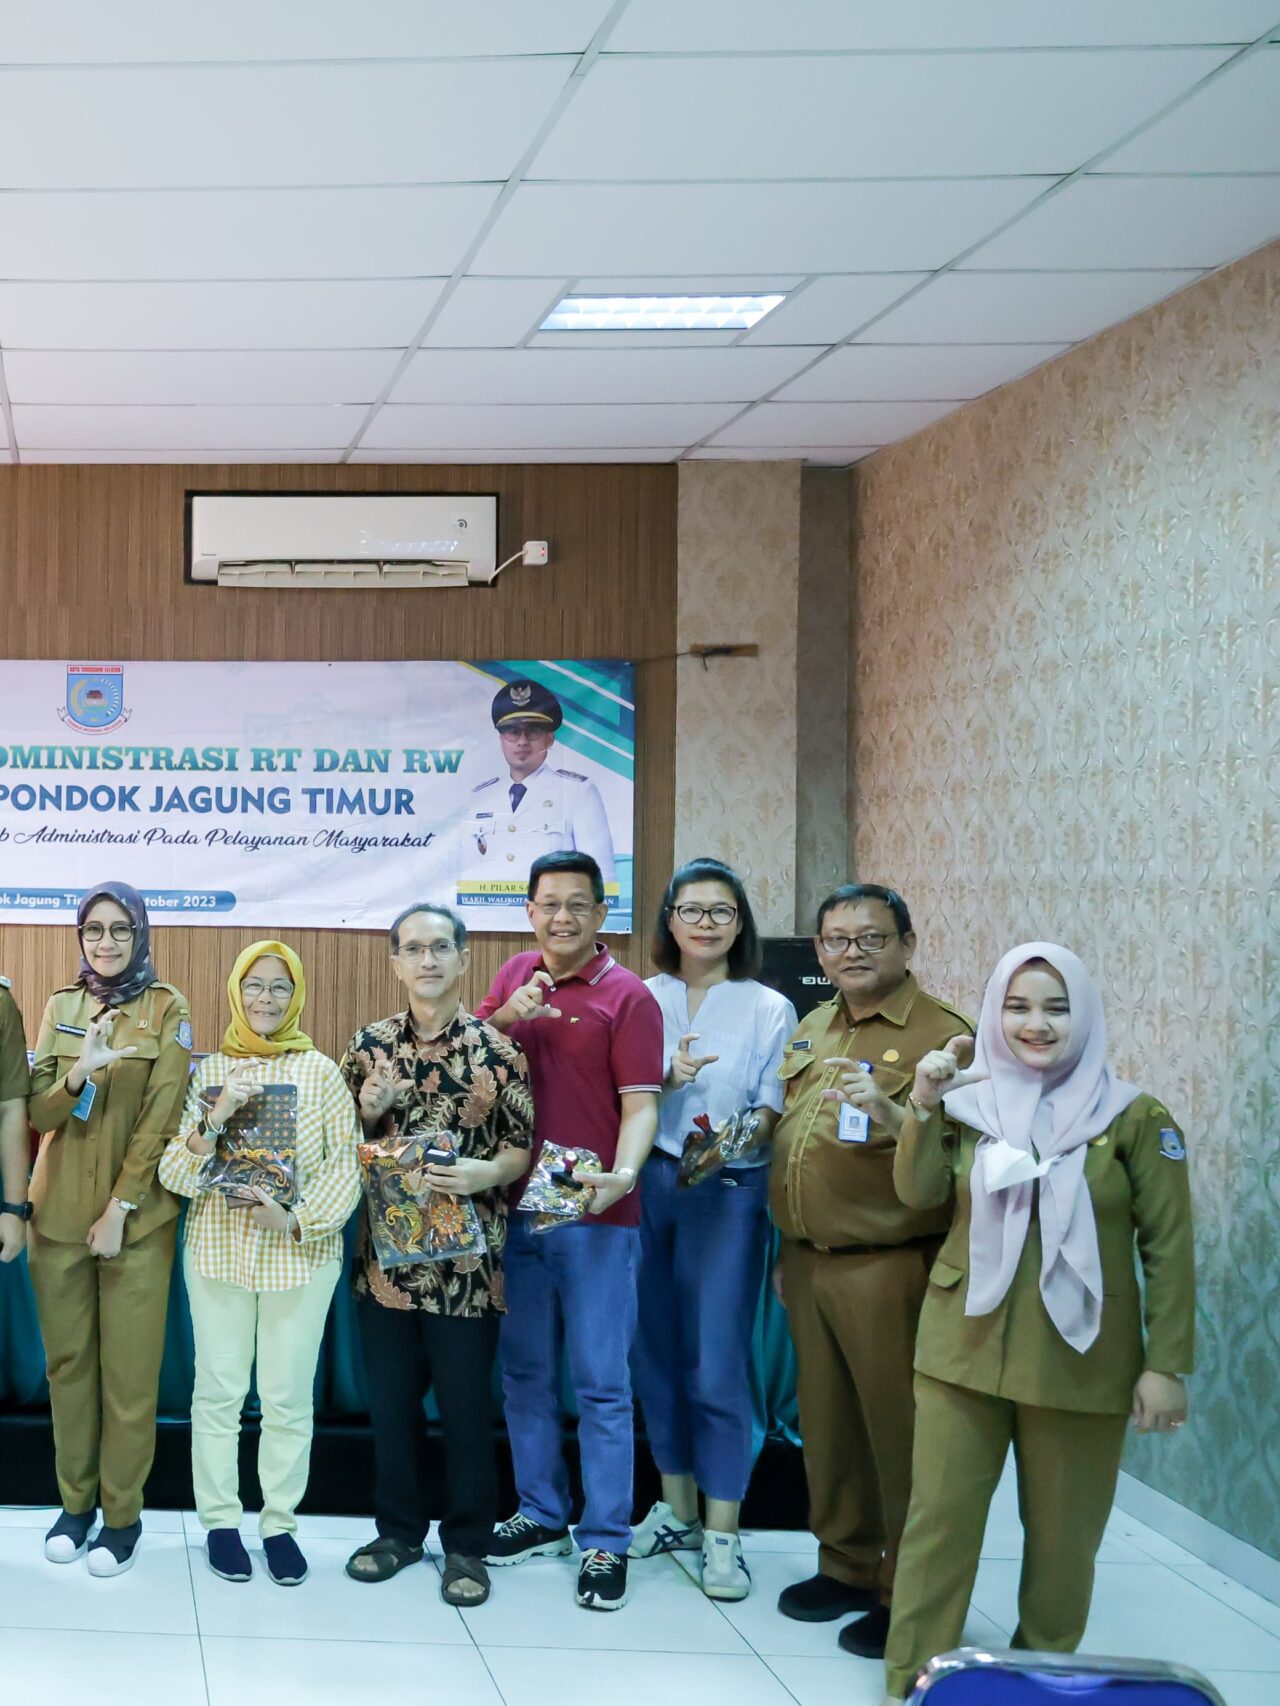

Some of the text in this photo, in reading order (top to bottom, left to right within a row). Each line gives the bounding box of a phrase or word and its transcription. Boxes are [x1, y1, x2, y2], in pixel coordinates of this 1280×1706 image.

[250, 747, 303, 773] RT
[312, 748, 392, 773] DAN
[402, 748, 465, 774] RW
[149, 785, 292, 815] JAGUNG
[301, 787, 417, 816] TIMUR
[13, 825, 141, 845] Administrasi
[142, 827, 202, 847] Pada
[204, 828, 310, 852] Pelayanan
[312, 829, 437, 854] Masyarakat
[490, 884, 517, 892] PILAR
[13, 893, 61, 908] Jagung
[182, 895, 217, 908] 2023
[460, 896, 486, 904] WAKIL
